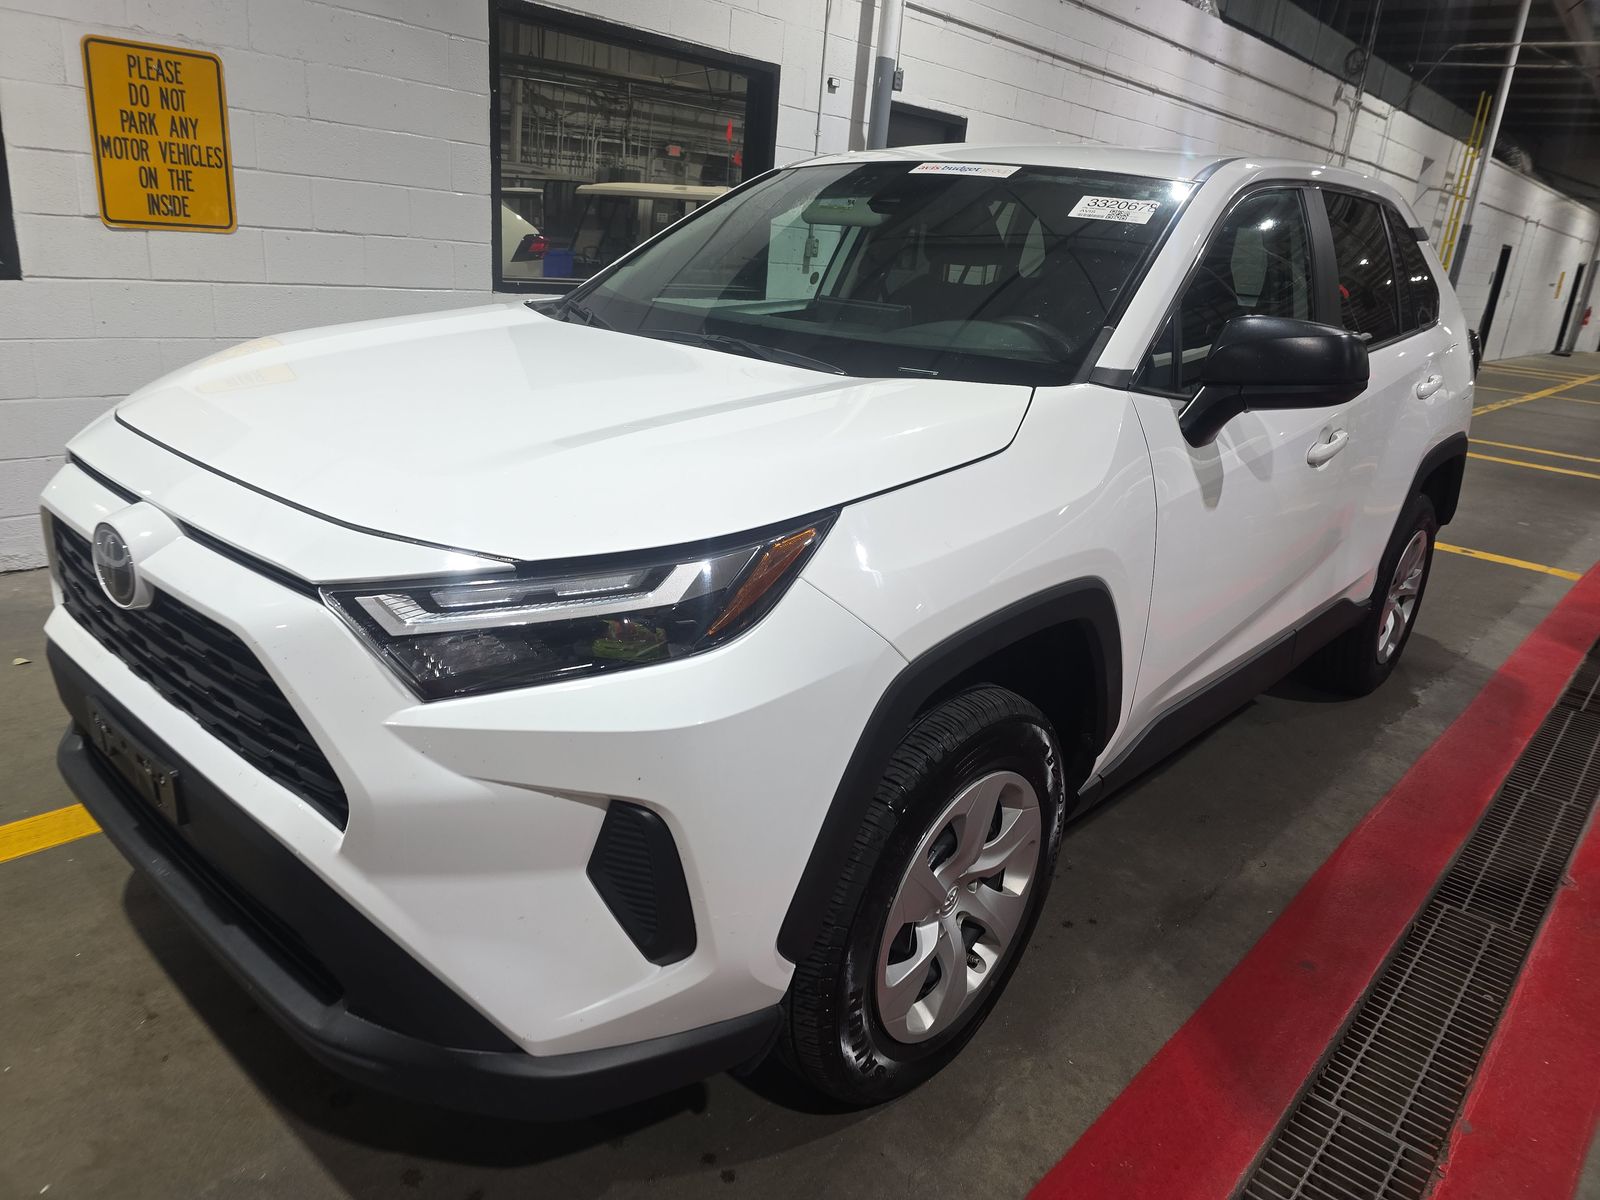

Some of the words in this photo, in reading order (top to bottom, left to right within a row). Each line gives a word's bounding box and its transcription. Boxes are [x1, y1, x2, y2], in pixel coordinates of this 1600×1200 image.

[127, 55, 183, 84] PLEASE
[128, 83, 150, 107] DO
[159, 87, 186, 112] NOT
[120, 109, 158, 136] PARK
[170, 118, 199, 140] ANY
[100, 136, 150, 162] MOTOR
[159, 141, 223, 169] VEHICLES
[139, 166, 159, 190] ON
[168, 168, 195, 193] THE
[941, 164, 981, 173] budget
[147, 193, 191, 218] INSIDE
